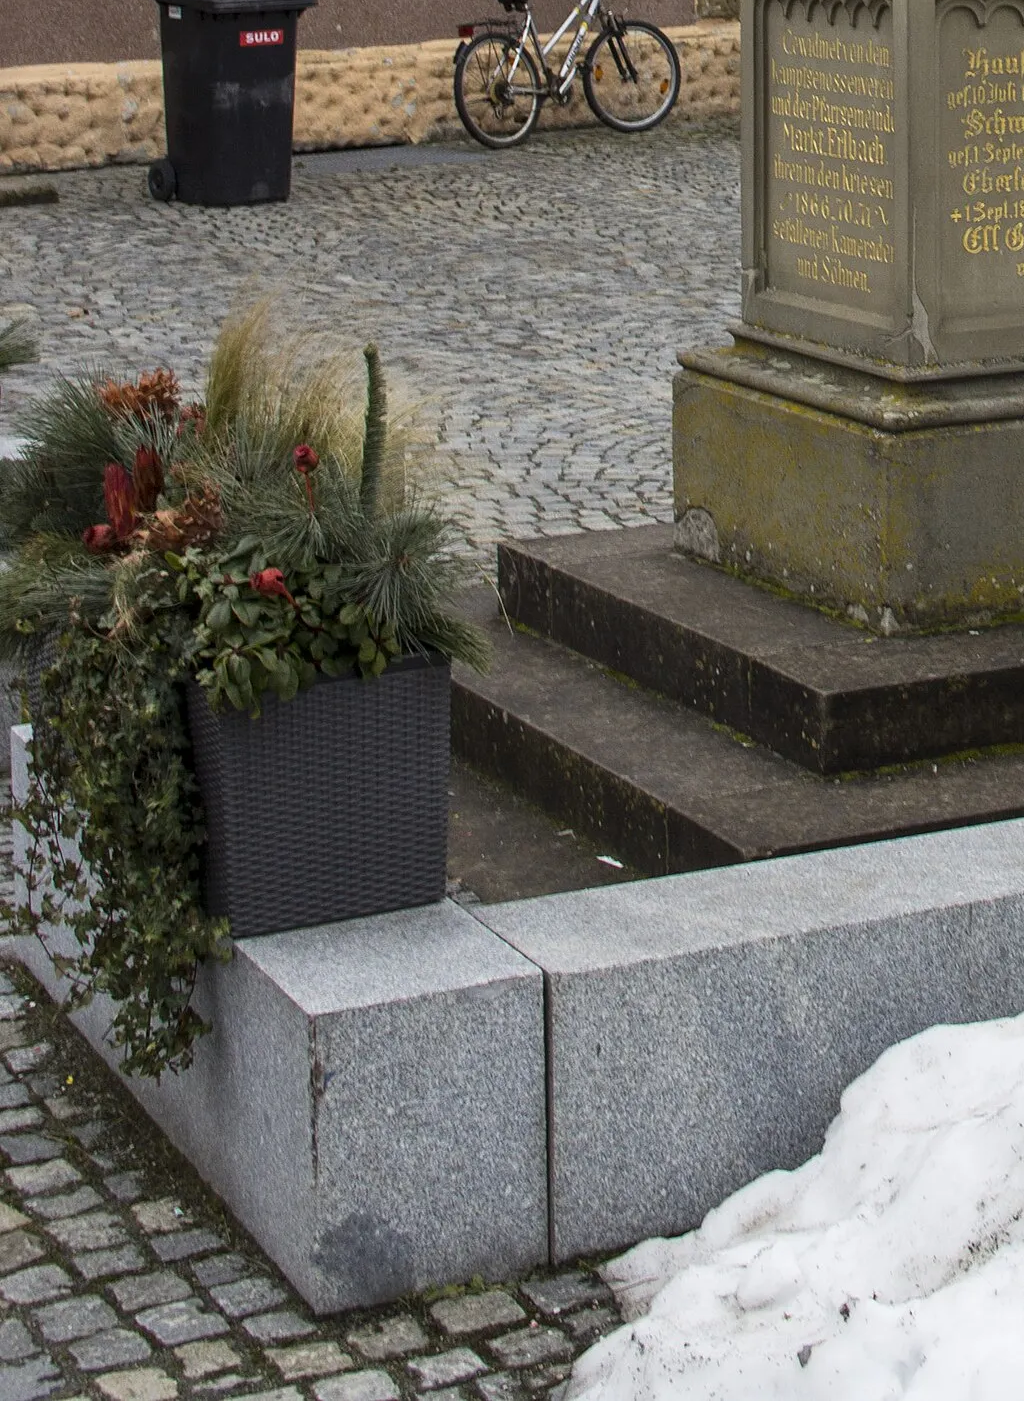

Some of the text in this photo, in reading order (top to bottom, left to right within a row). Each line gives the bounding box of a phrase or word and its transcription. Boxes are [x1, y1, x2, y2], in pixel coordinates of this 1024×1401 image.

[246, 31, 279, 44] SULO
[772, 91, 790, 117] und
[793, 92, 811, 120] der
[818, 159, 839, 189] den
[797, 253, 818, 280] und
